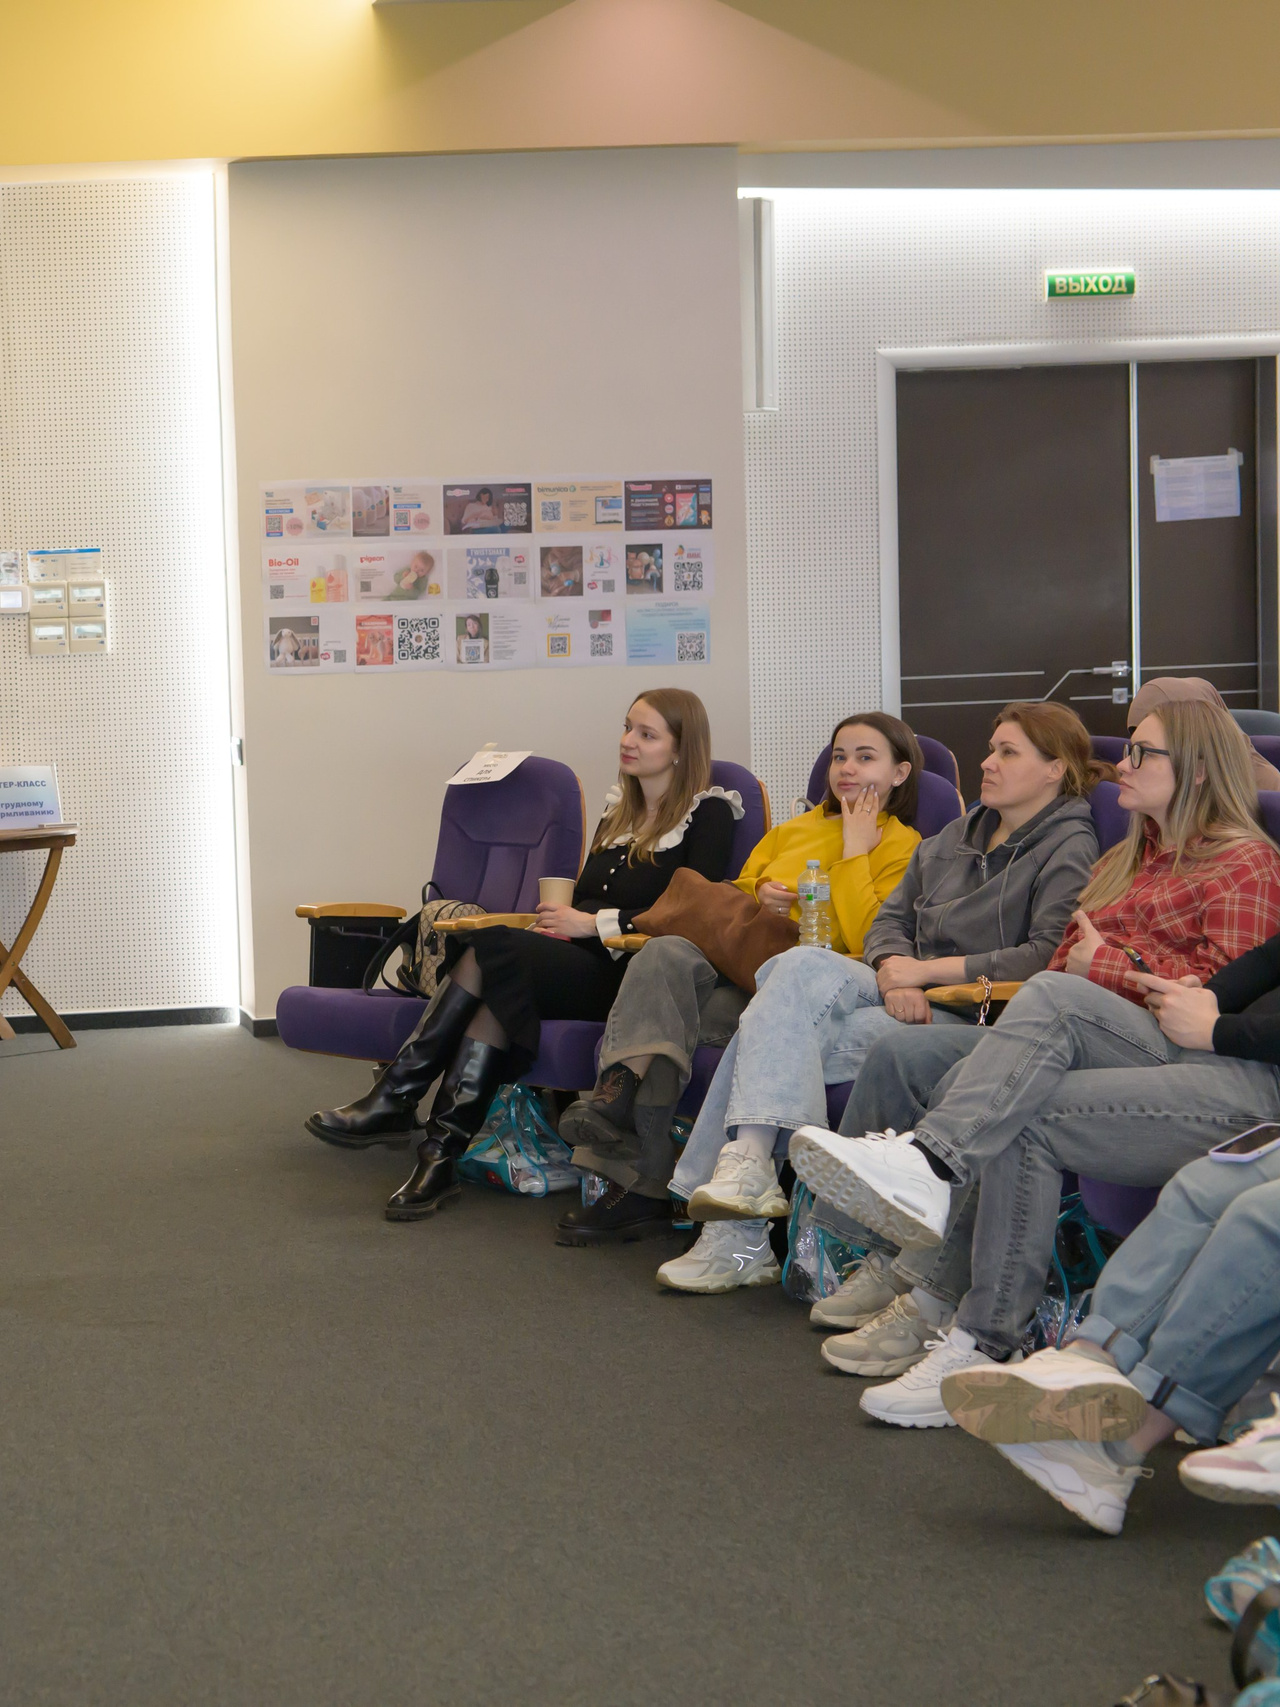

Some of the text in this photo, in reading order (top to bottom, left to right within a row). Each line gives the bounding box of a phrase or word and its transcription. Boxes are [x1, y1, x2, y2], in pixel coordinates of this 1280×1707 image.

[1055, 274, 1128, 294] ВЫХОД
[268, 557, 300, 567] Bio-Oil
[0, 801, 45, 810] грудному
